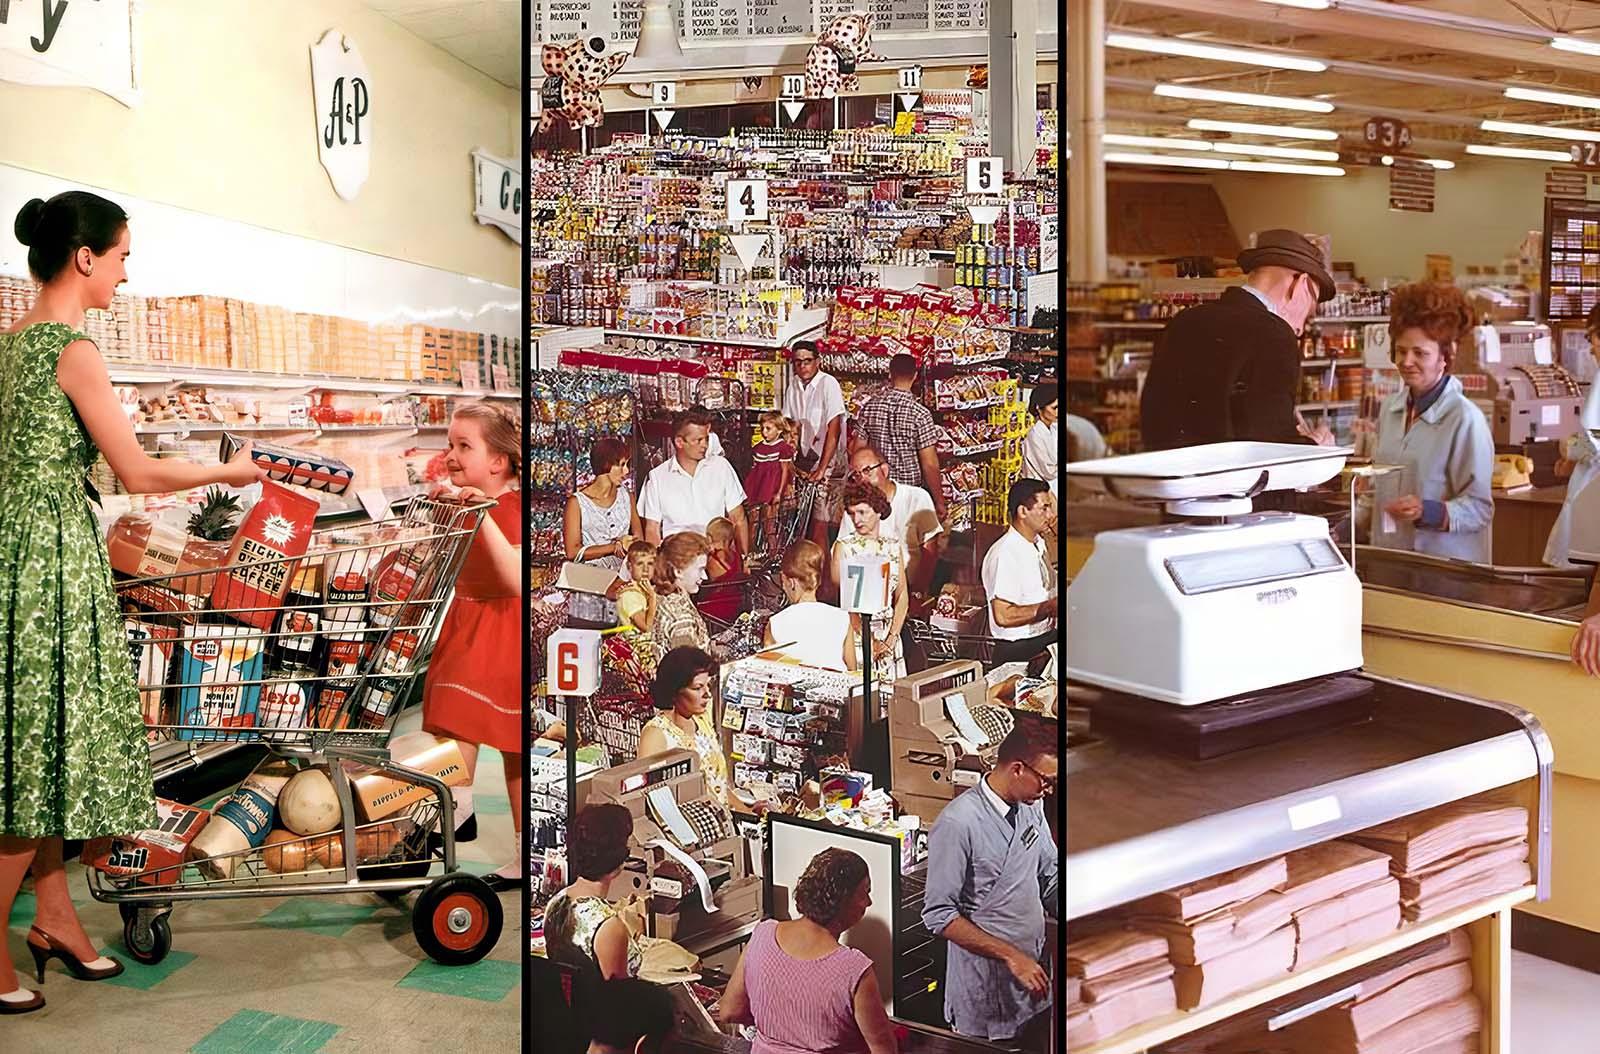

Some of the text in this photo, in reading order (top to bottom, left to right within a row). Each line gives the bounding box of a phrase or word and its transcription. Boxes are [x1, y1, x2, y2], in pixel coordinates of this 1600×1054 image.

[660, 85, 669, 101] 9
[788, 78, 801, 94] 10
[904, 71, 916, 87] 11
[324, 77, 369, 149] A&P
[1381, 122, 1394, 147] 3
[979, 161, 991, 189] 5
[739, 184, 755, 216] 4
[847, 564, 865, 609] 7
[558, 643, 579, 691] 6
[109, 840, 149, 869] Sail
